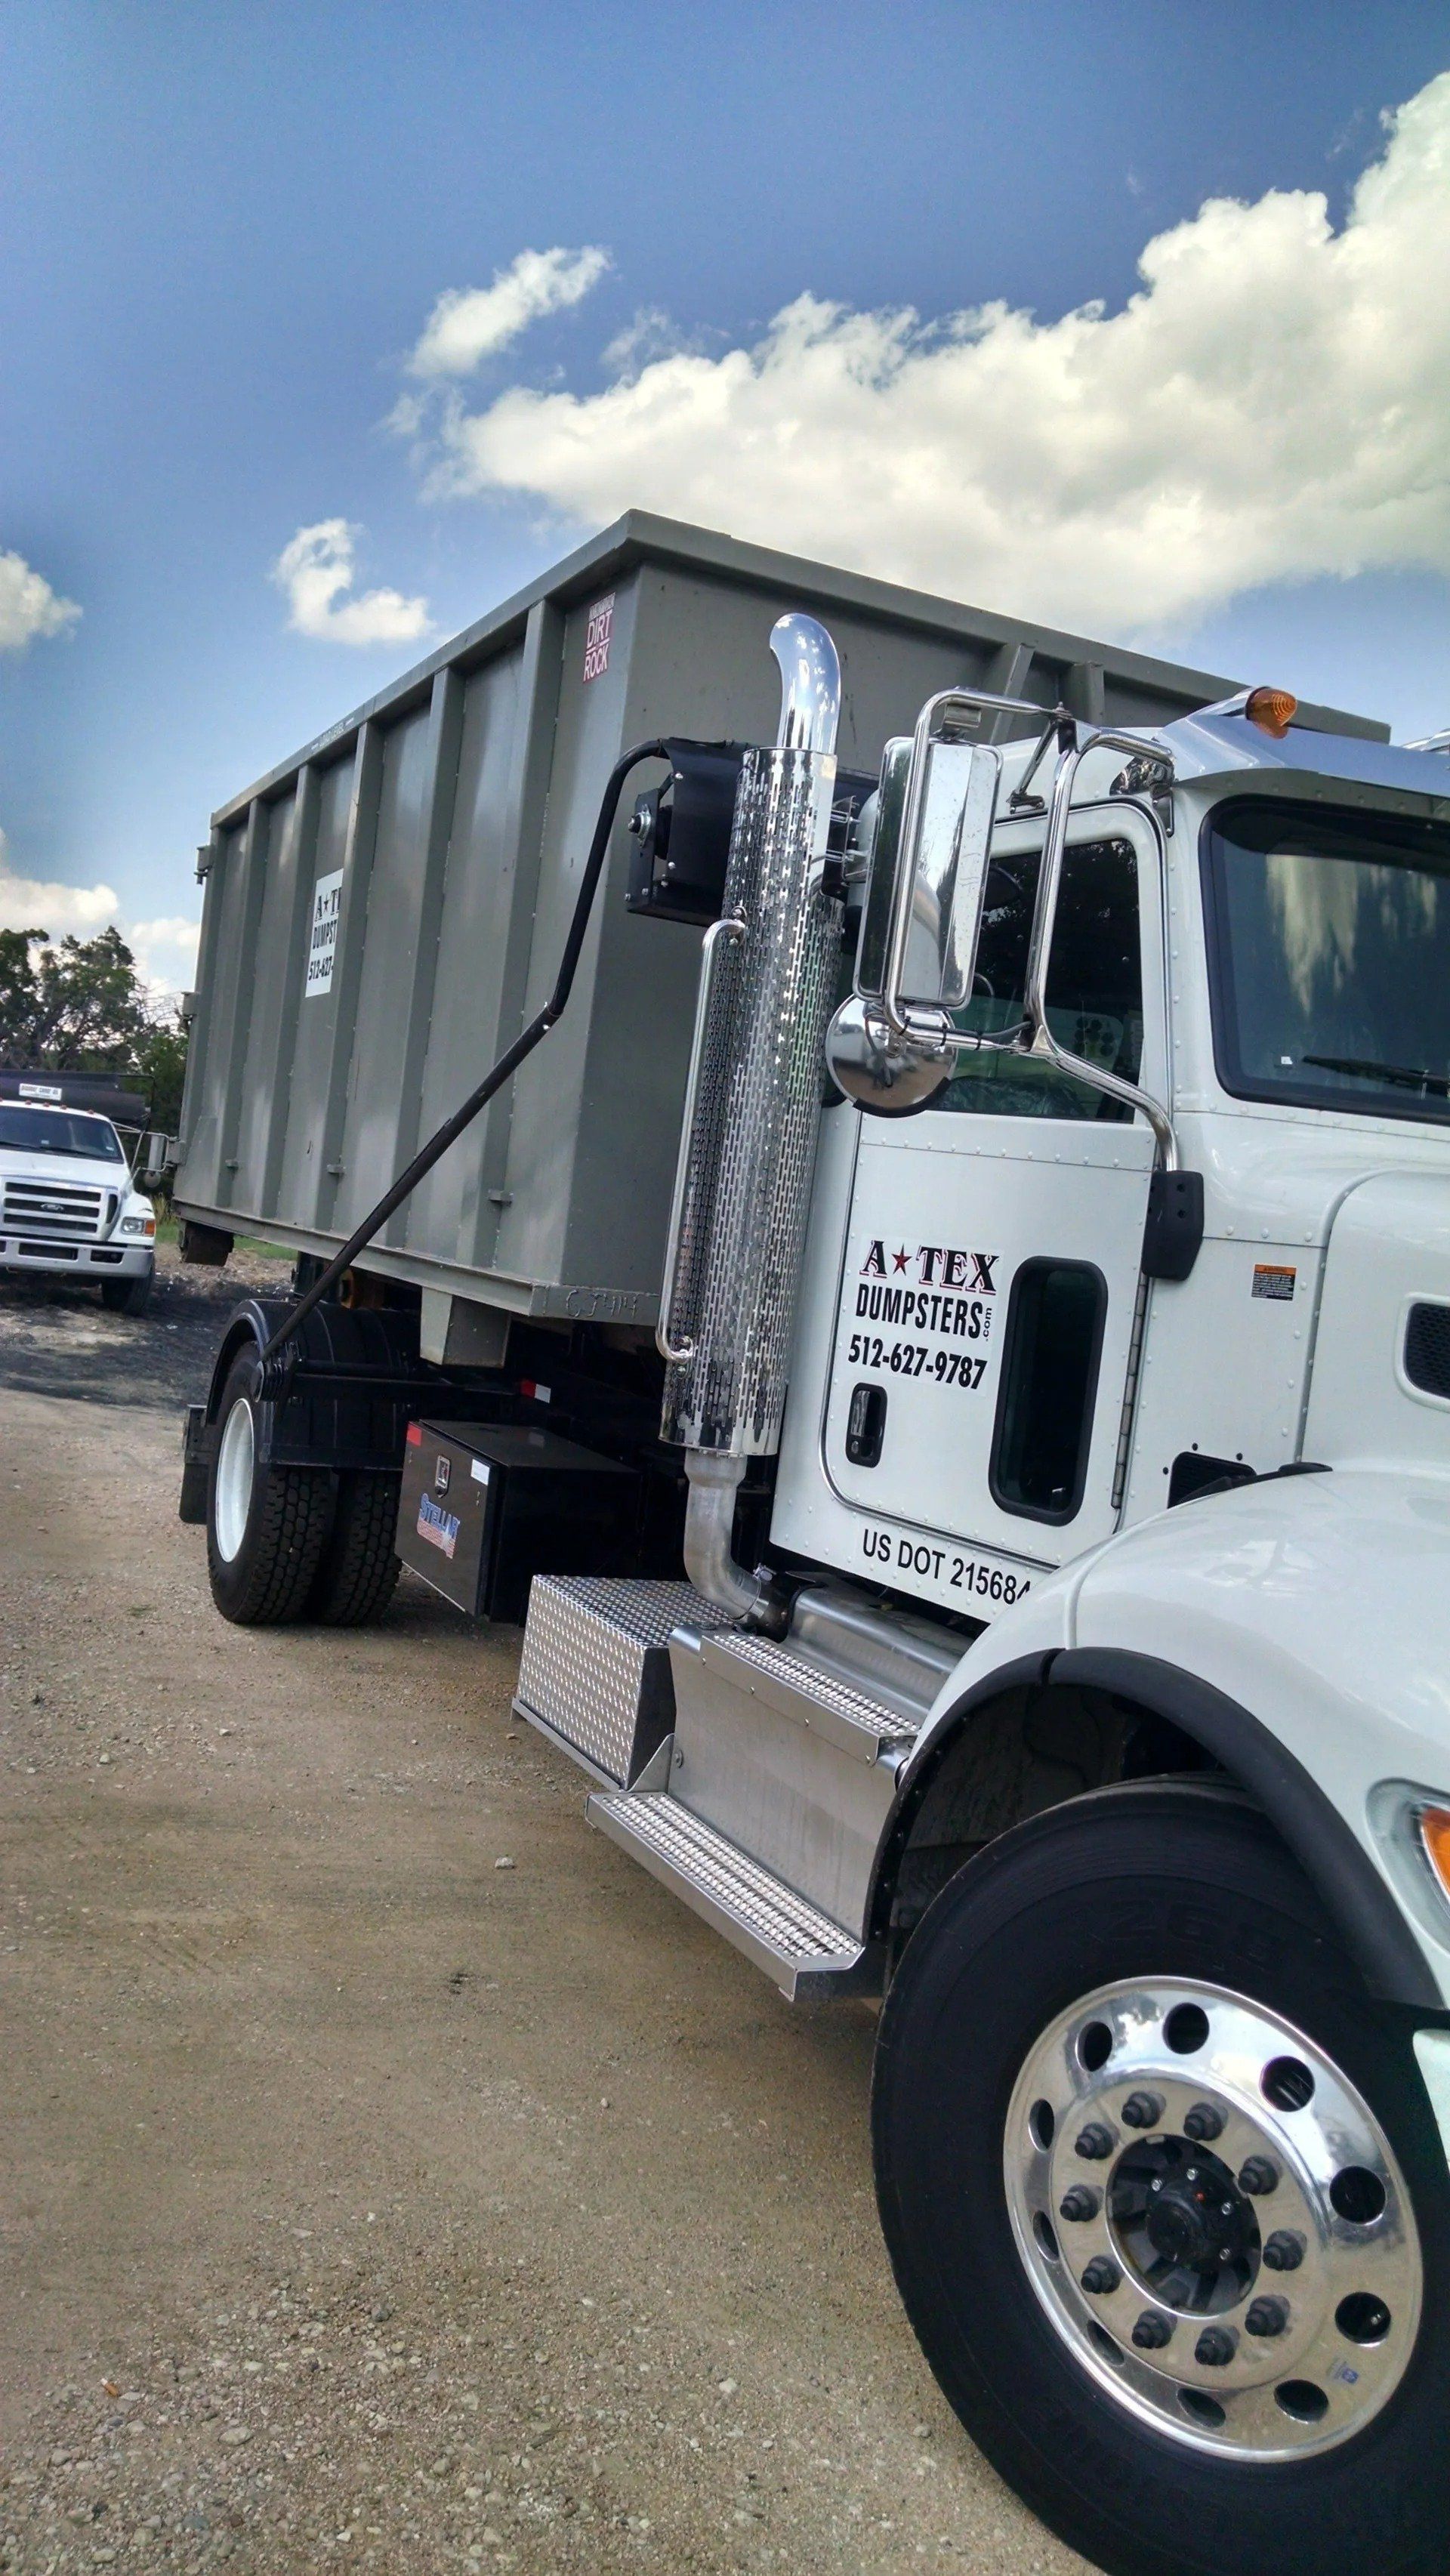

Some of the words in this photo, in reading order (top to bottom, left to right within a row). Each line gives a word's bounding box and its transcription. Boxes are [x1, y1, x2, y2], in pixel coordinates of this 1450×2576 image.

[587, 608, 613, 649] DIRT
[583, 643, 609, 682] ROCK
[856, 1283, 983, 1339] DUMPSTERS
[848, 1334, 988, 1390] 512-627-9787
[862, 1529, 892, 1563] US
[897, 1540, 946, 1579] DOT
